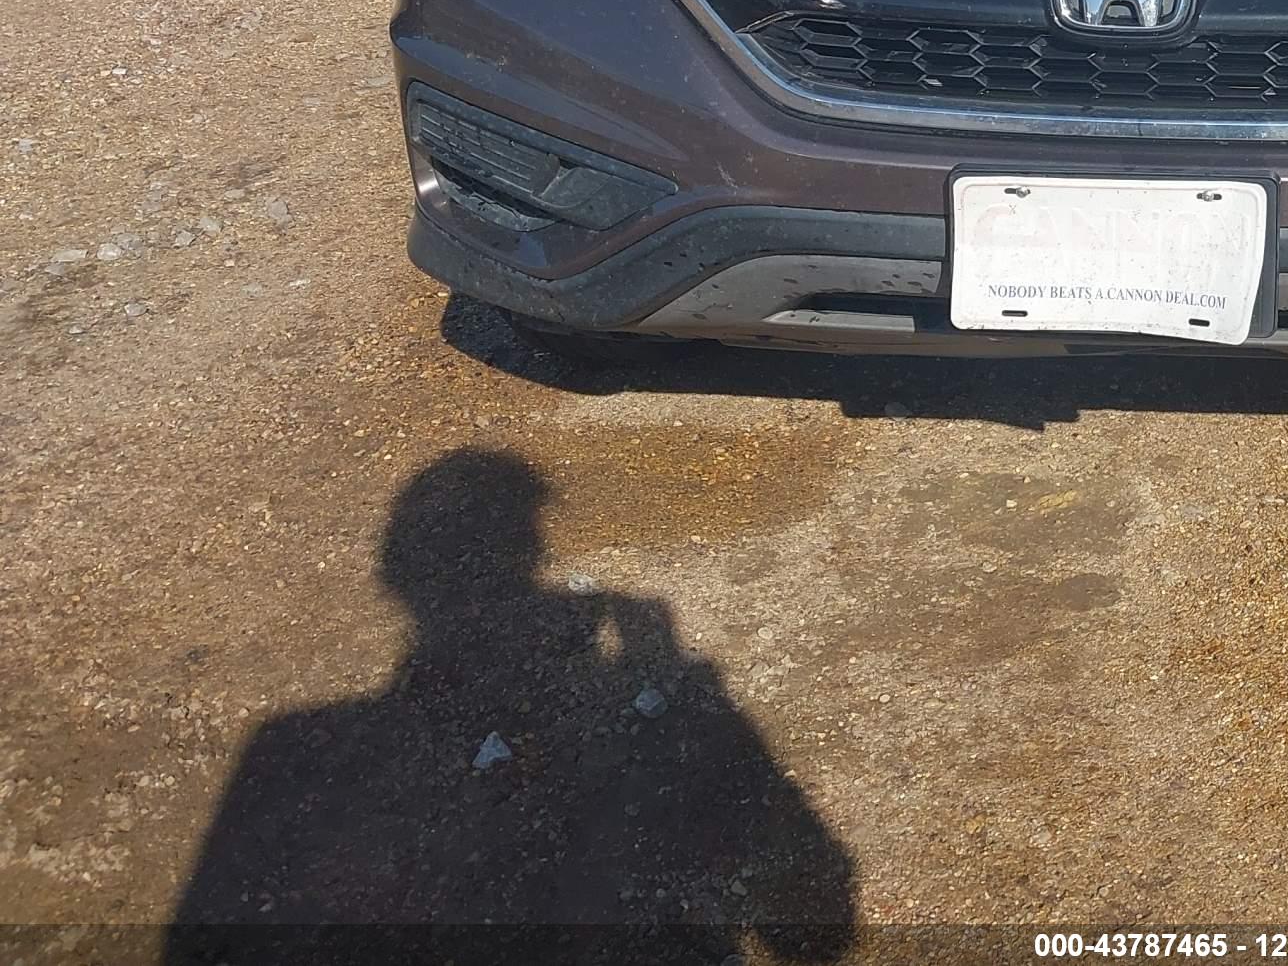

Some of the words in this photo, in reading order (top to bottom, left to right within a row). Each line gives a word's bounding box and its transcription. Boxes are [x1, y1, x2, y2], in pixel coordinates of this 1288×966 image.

[987, 284, 1047, 299] NOBODY
[1049, 285, 1092, 300] BEATS
[1094, 288, 1104, 300] A
[1106, 287, 1163, 303] CANNON
